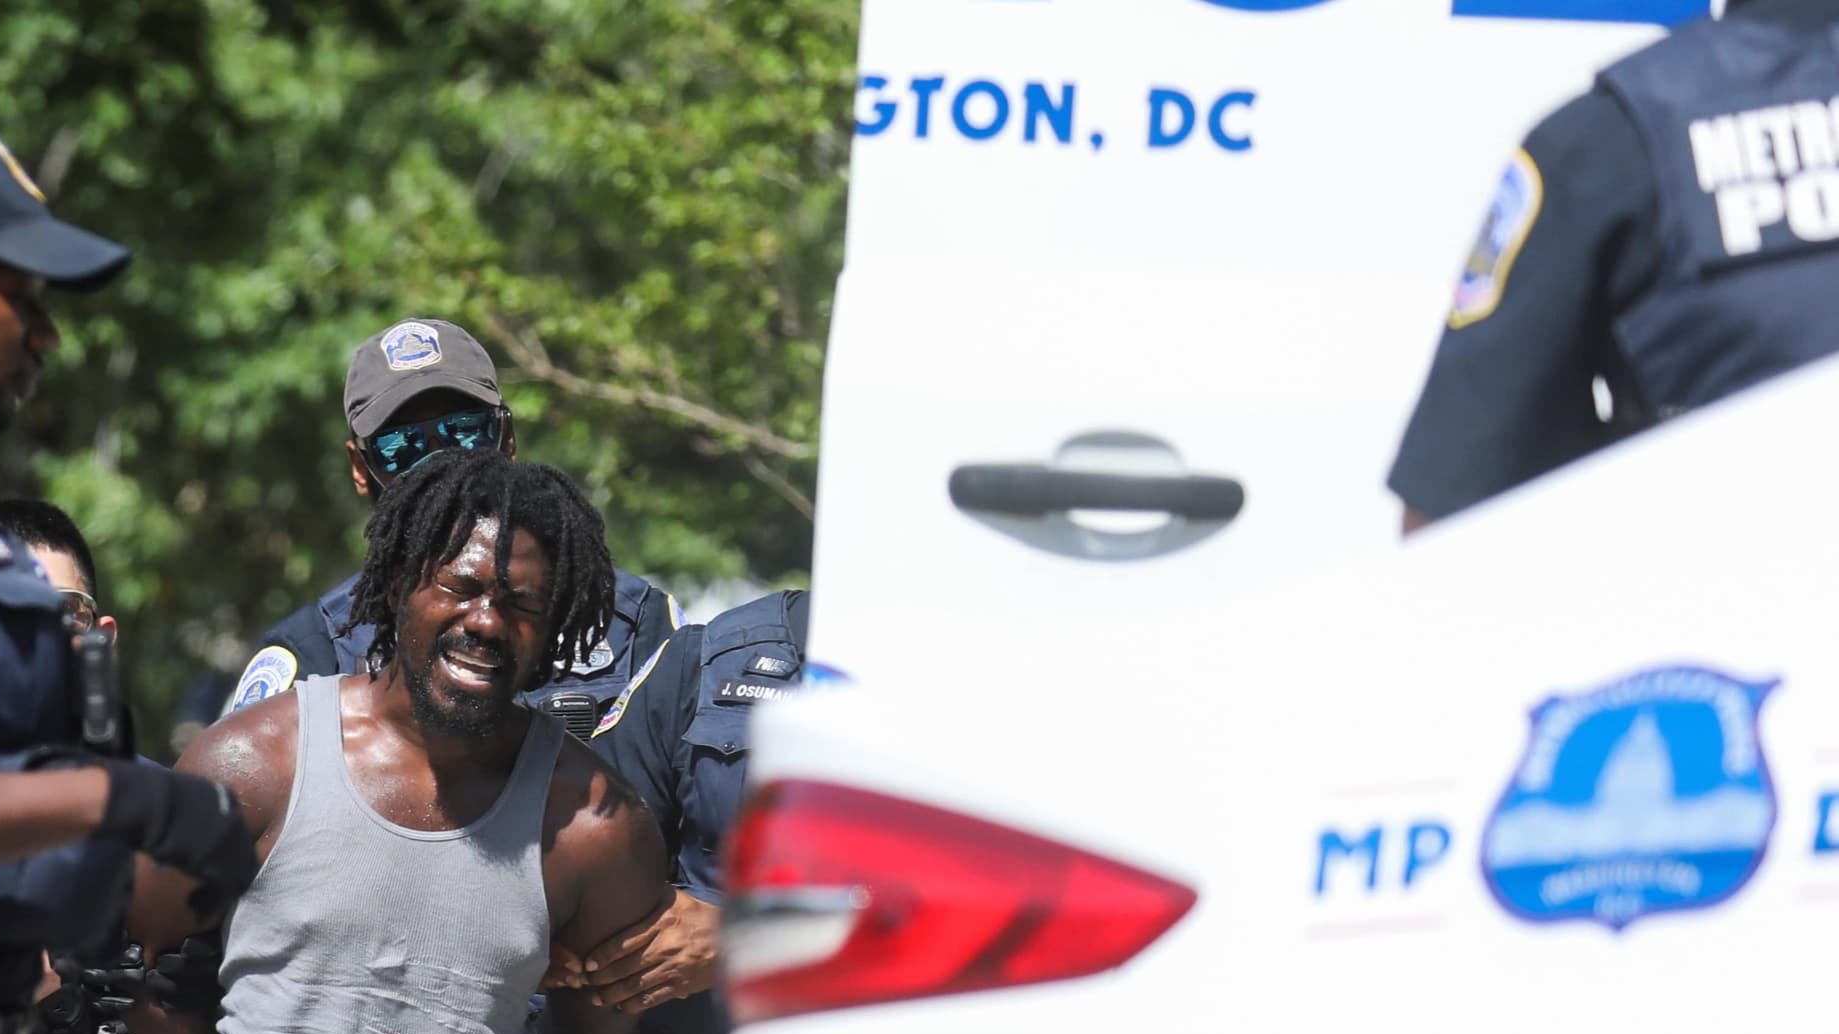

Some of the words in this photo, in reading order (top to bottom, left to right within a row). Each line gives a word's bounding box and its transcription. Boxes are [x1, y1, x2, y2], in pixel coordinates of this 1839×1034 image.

[854, 75, 1104, 150] GTON,
[1147, 88, 1256, 152] DC
[1688, 94, 1839, 193] METR
[721, 682, 732, 696] J.
